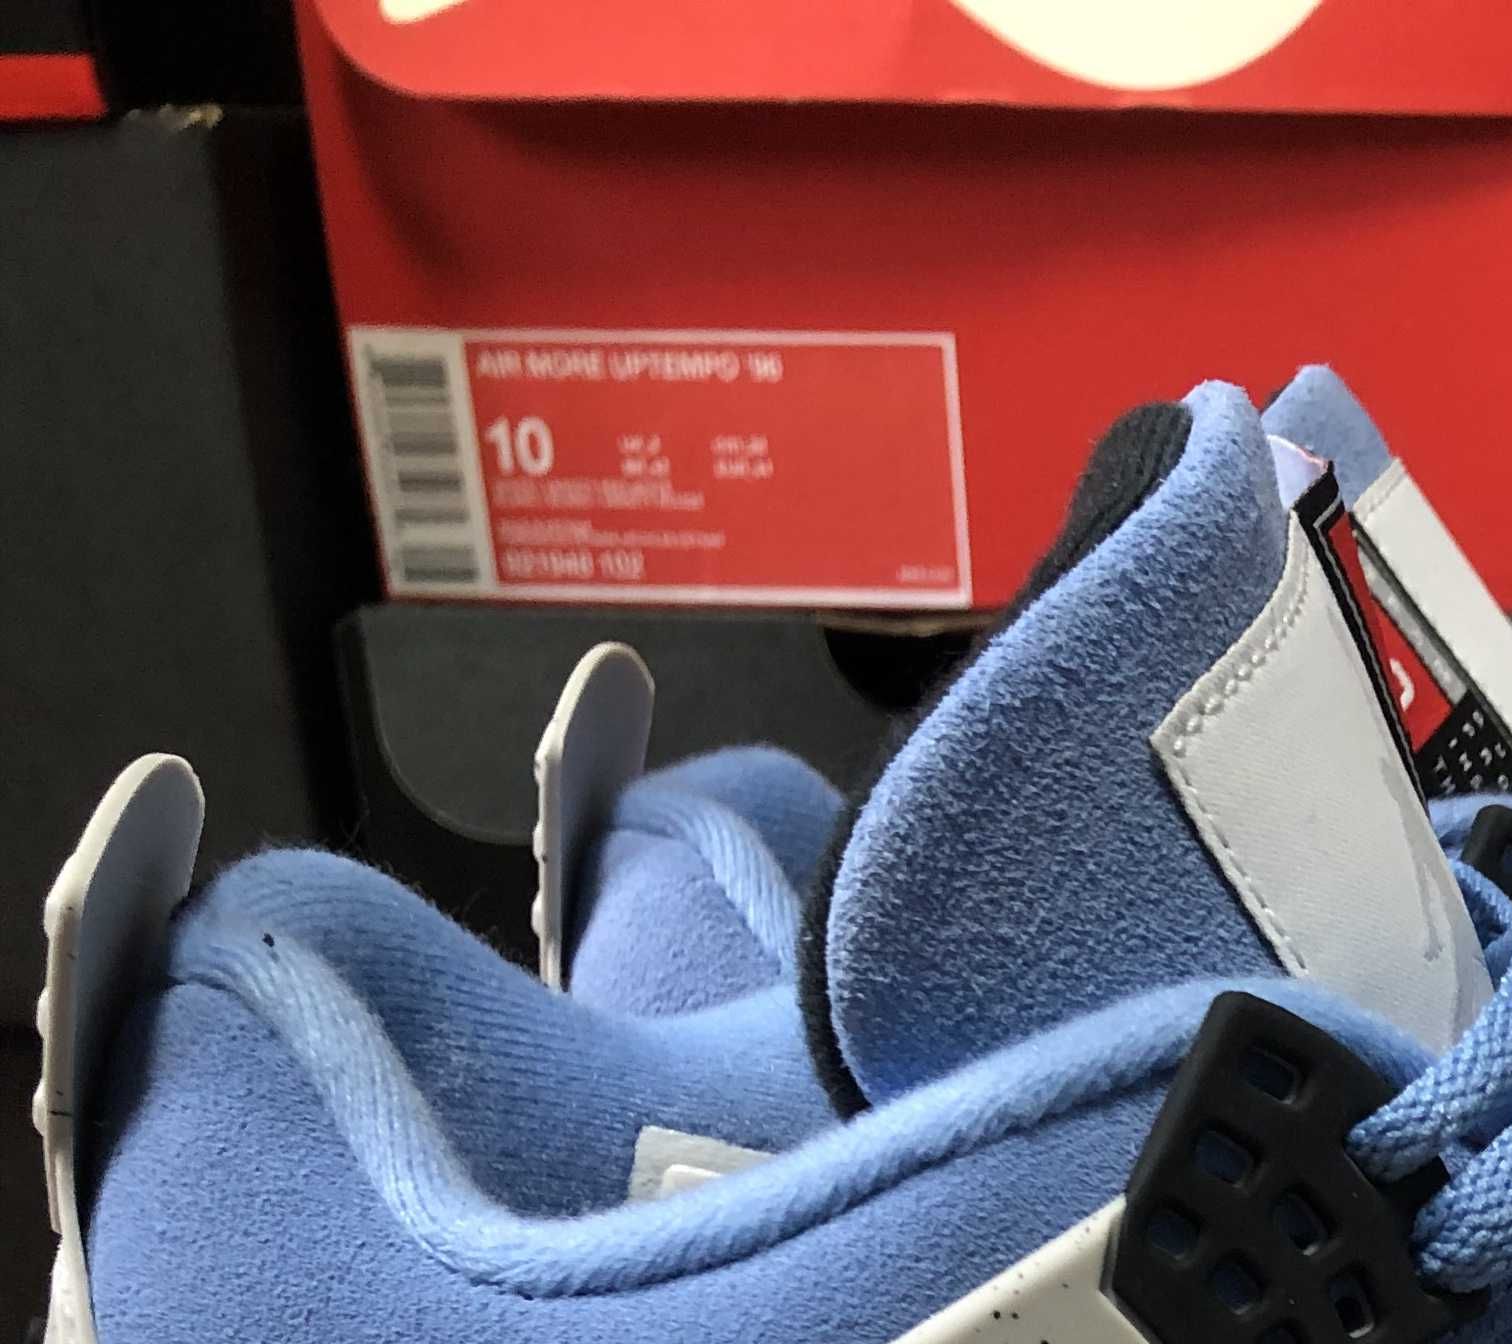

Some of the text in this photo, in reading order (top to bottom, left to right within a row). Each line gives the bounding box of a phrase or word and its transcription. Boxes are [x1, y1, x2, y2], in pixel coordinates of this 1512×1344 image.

[477, 350, 522, 378] AIR
[525, 350, 602, 380] MORE
[608, 351, 740, 382] UPTEMPO
[484, 415, 554, 477] 10
